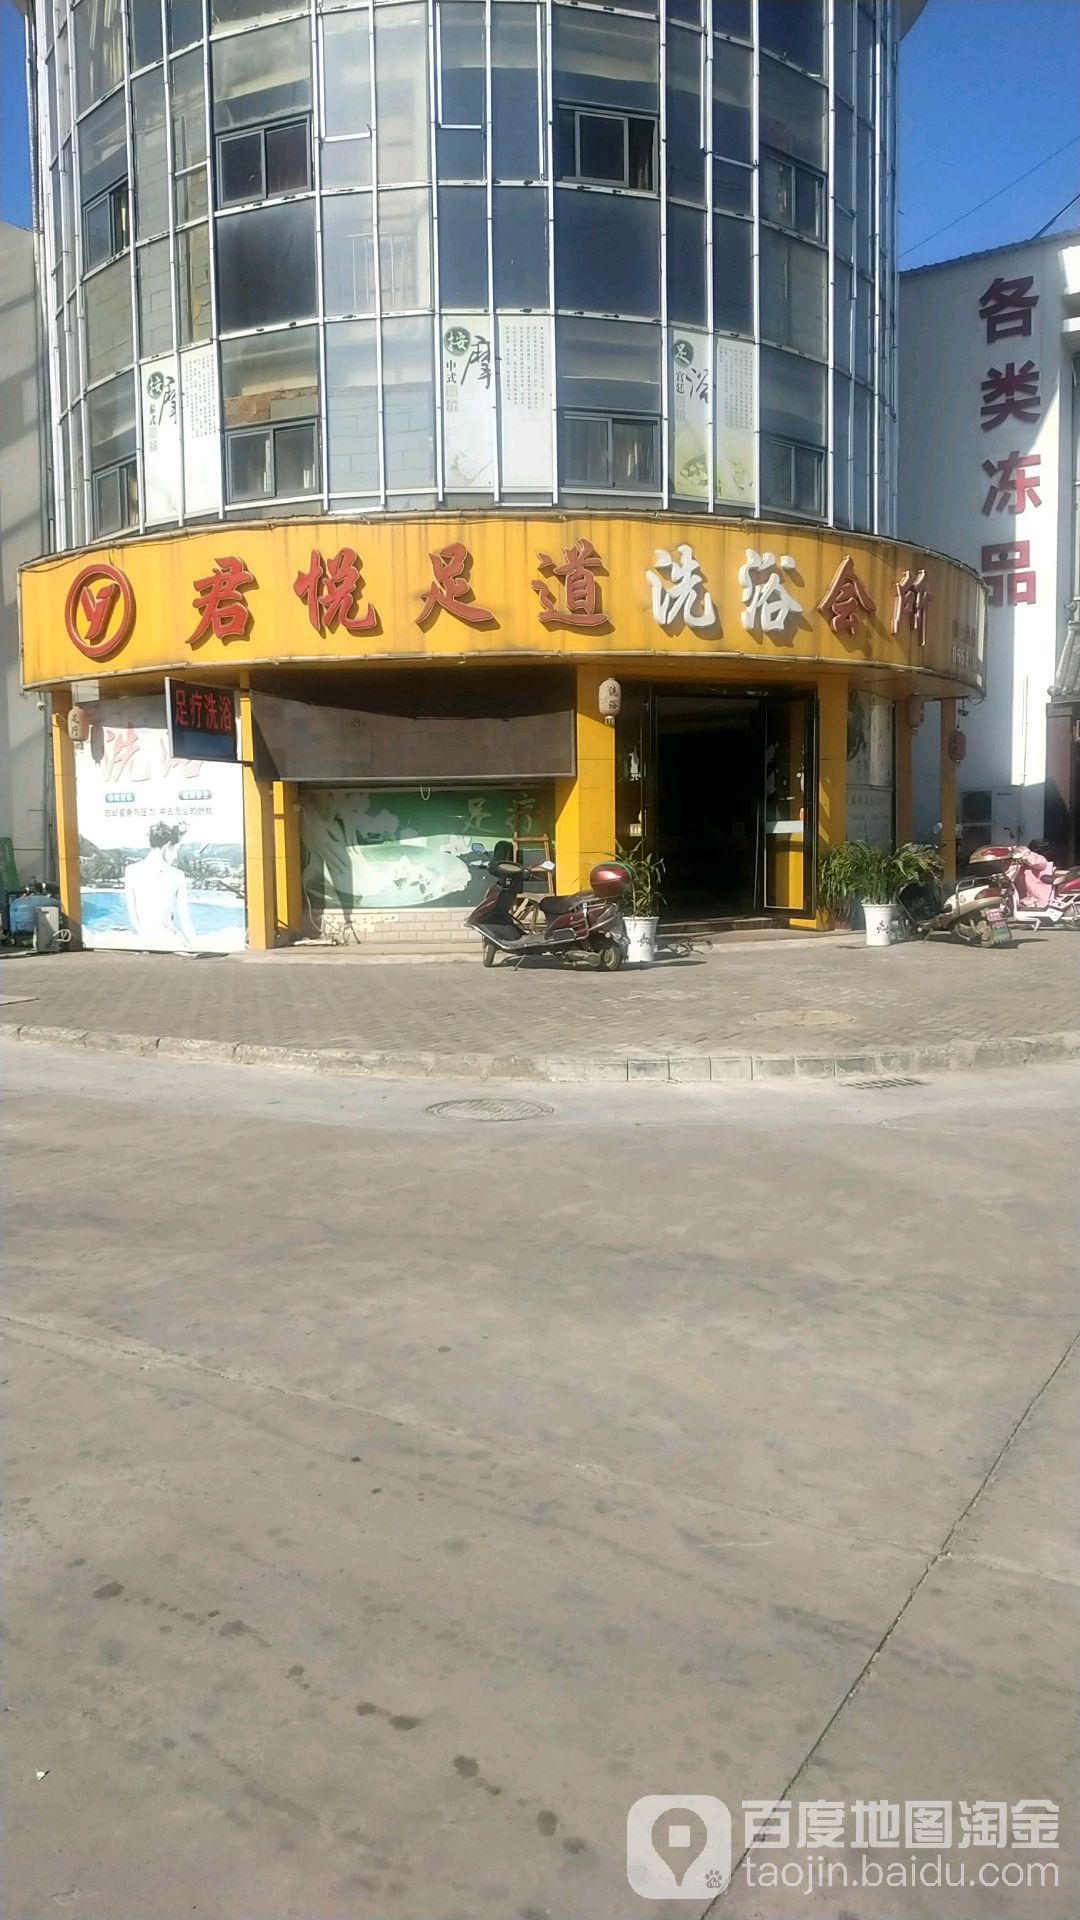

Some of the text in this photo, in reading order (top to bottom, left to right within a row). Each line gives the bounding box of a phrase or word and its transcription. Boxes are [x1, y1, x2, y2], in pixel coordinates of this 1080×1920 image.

[978, 275, 1042, 606] 各类冻品
[174, 688, 233, 733] 足疗洗浴
